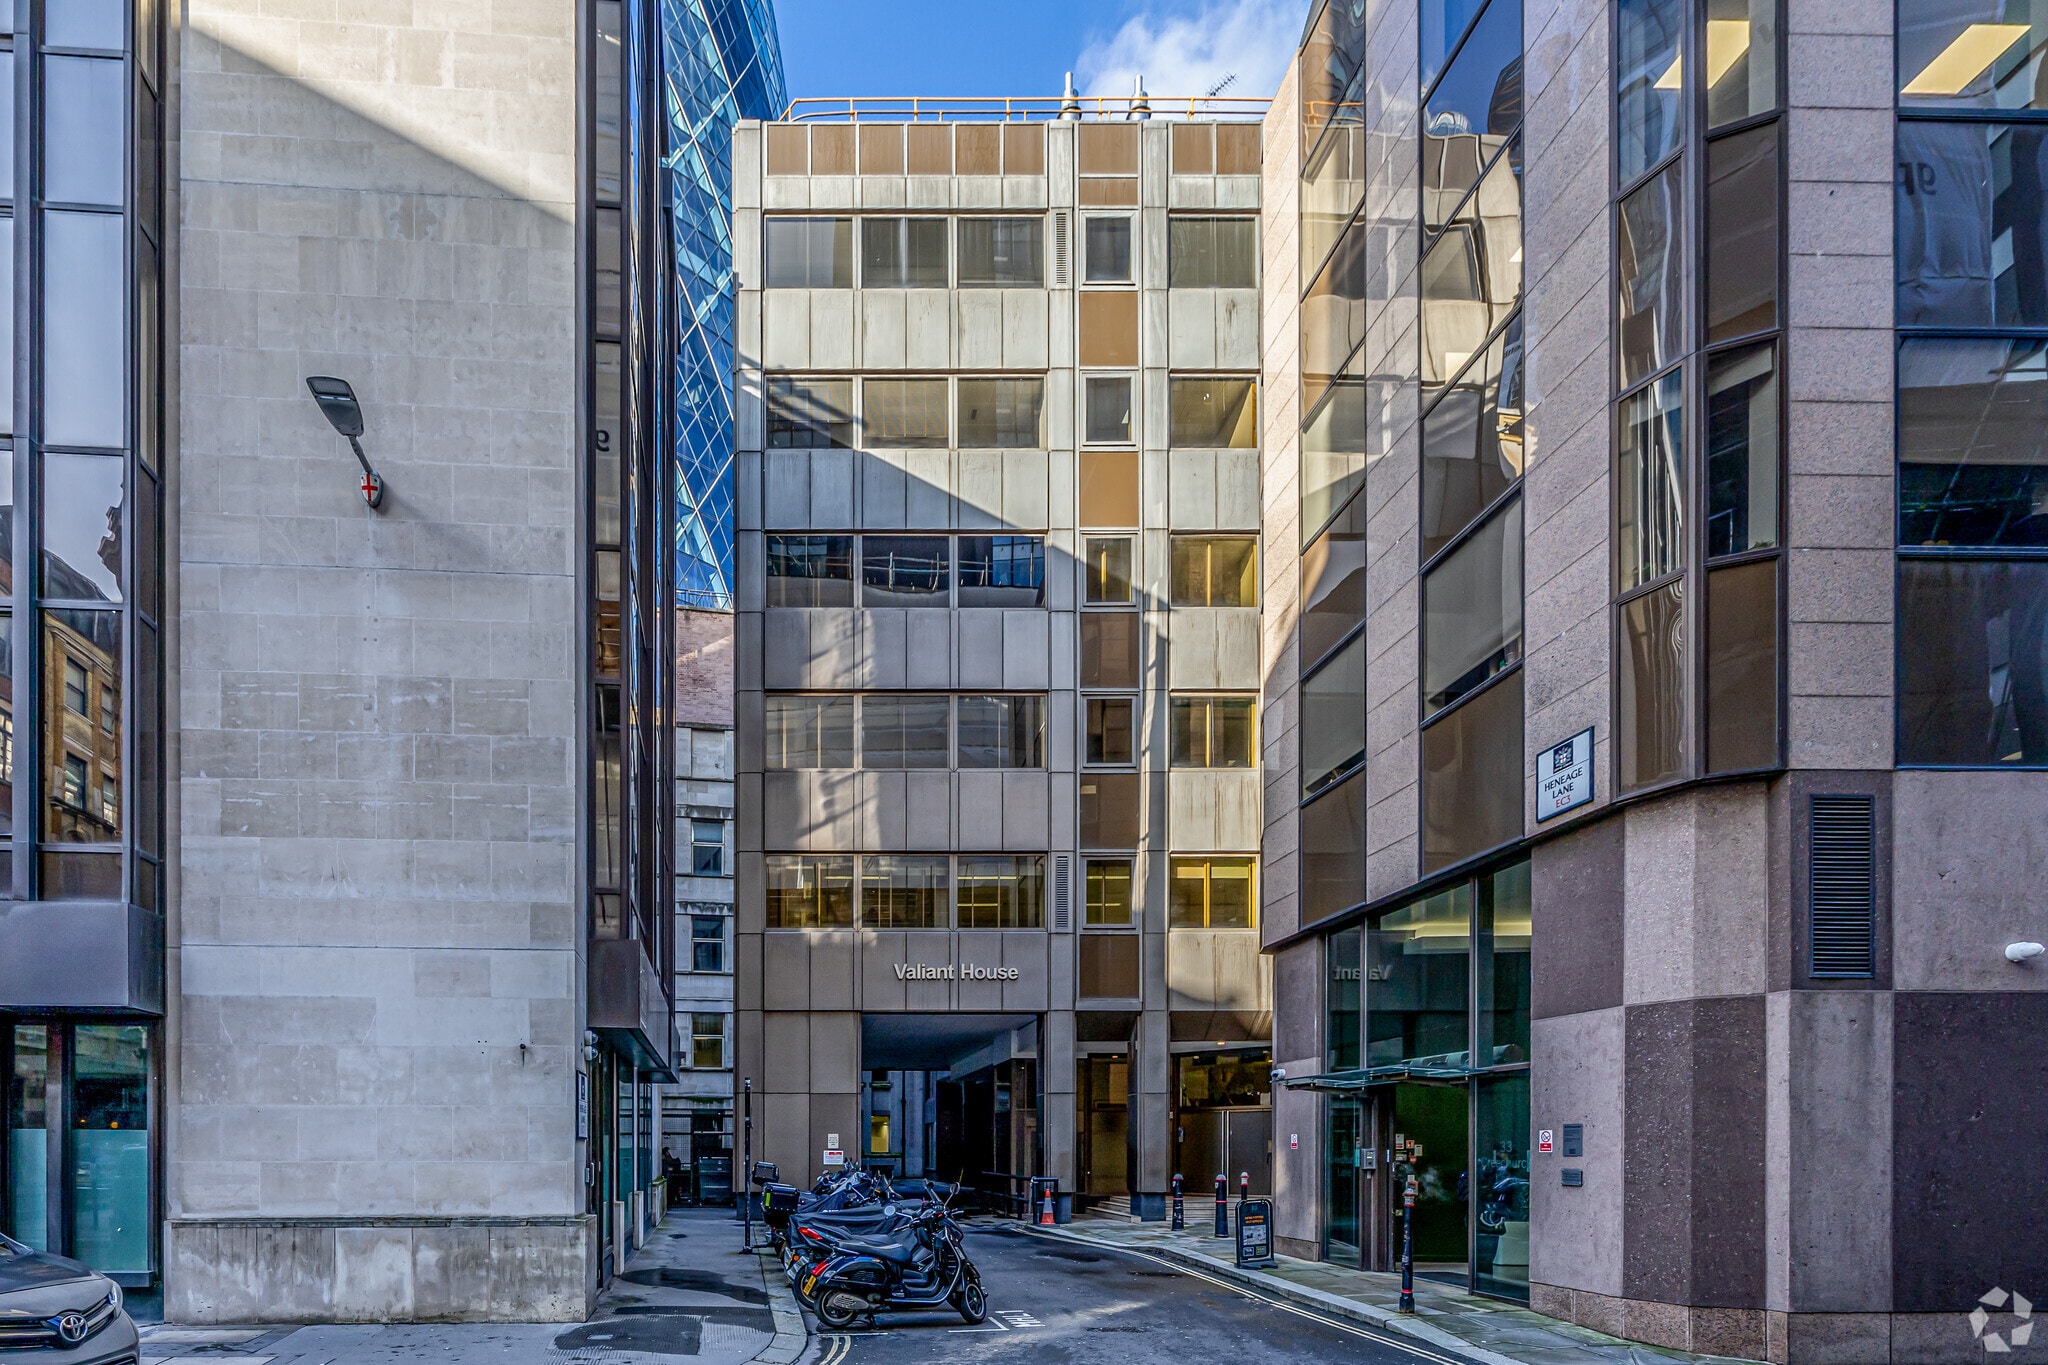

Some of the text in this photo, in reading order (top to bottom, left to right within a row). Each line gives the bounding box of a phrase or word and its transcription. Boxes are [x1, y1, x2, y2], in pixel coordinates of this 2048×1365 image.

[1544, 767, 1583, 792] HENEAGE
[1552, 782, 1574, 799] LANE
[1555, 795, 1571, 808] EC3
[894, 963, 1019, 980] Valiant House
[1480, 1156, 1531, 1169] Creechurc
